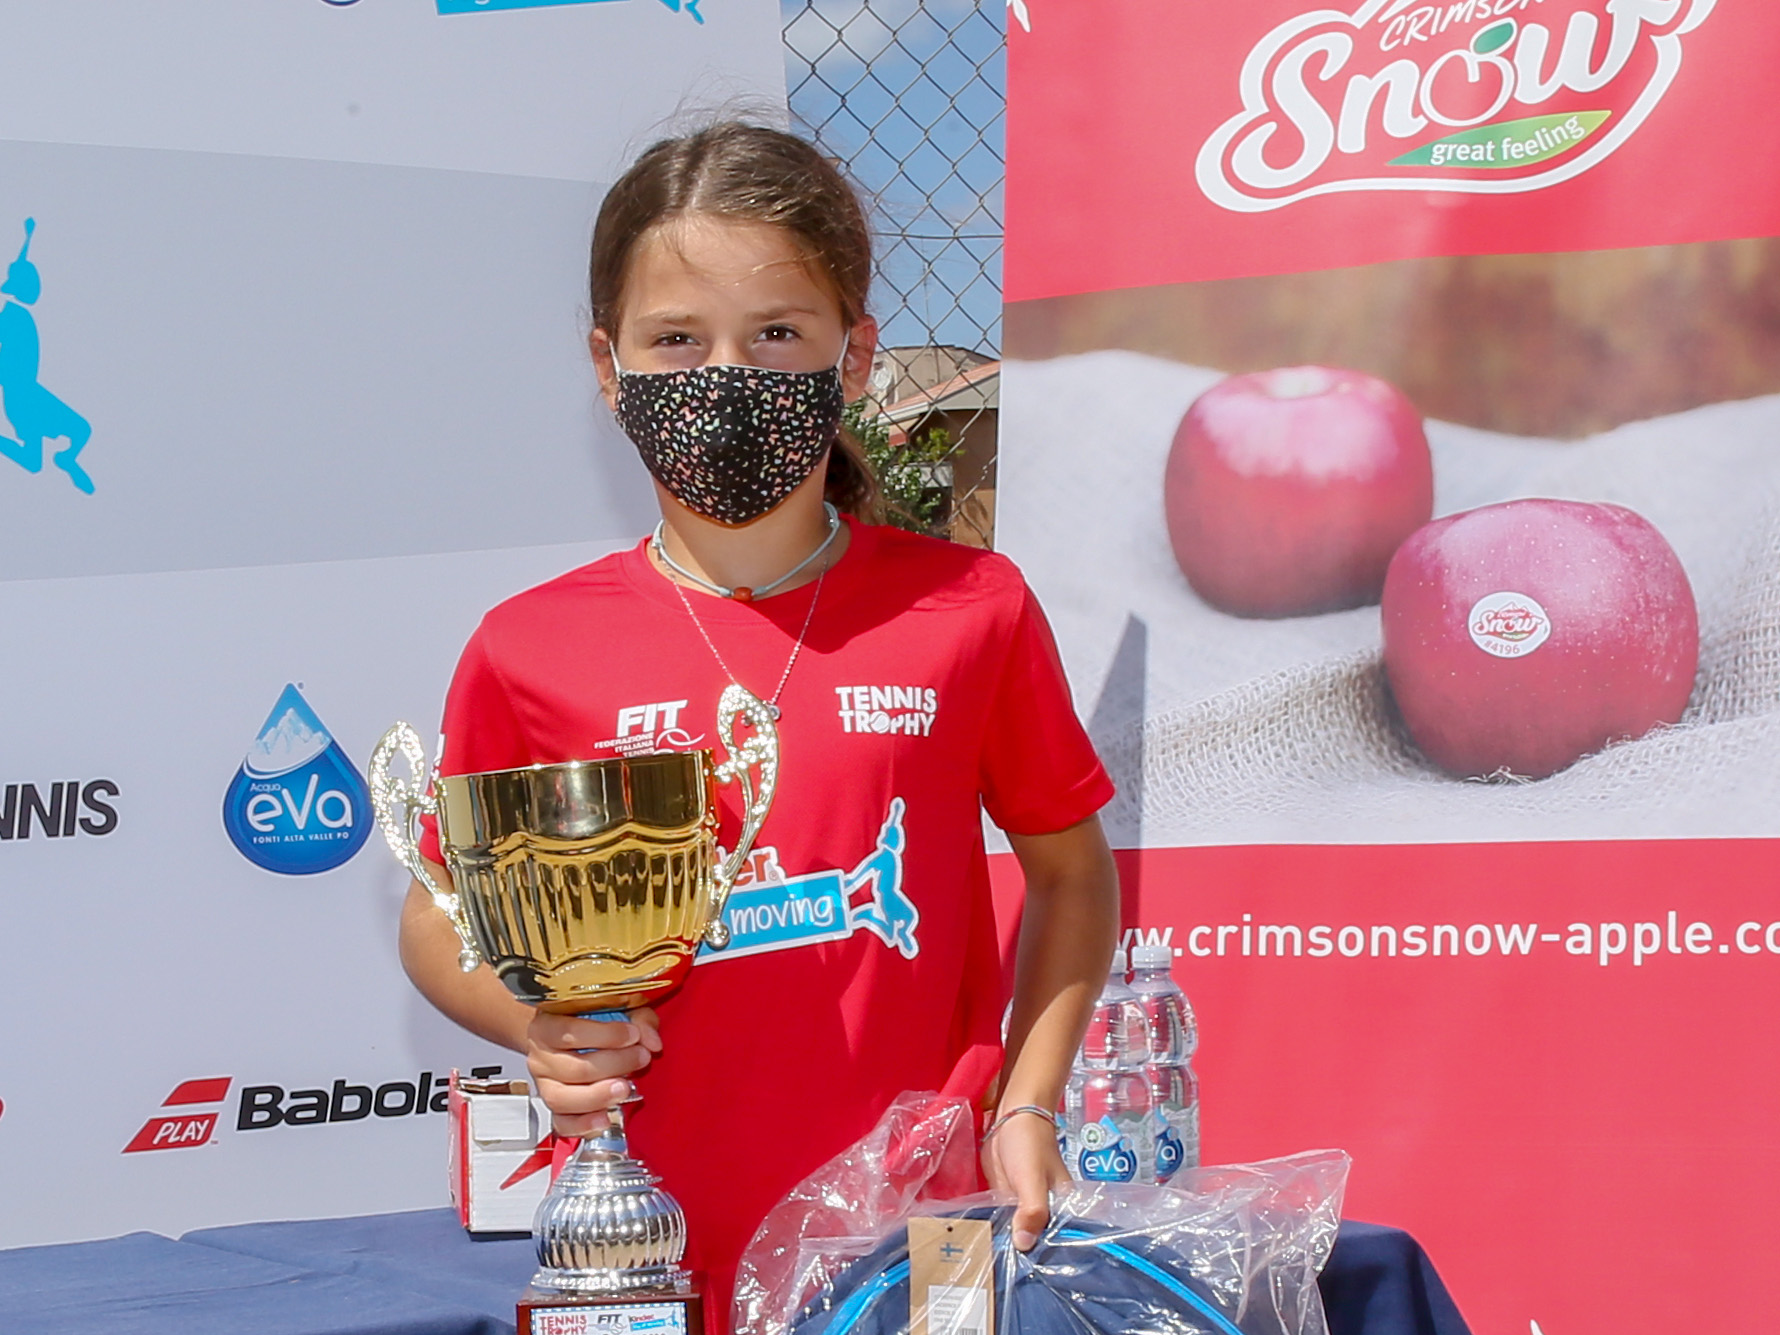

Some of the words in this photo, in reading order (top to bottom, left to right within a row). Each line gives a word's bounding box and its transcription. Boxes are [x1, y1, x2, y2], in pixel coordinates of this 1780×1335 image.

[1379, 0, 1545, 51] CRIMS
[1232, 0, 1681, 189] Snow
[1430, 138, 1496, 166] great
[1501, 115, 1586, 161] feeling
[1473, 610, 1545, 635] Snow
[1484, 640, 1521, 655] #4196
[835, 685, 938, 714] TENNIS
[617, 699, 689, 738] FIT
[838, 710, 936, 737] TROPHY
[594, 732, 655, 749] FEDERAZIONE
[614, 740, 655, 753] ITALIANA
[253, 836, 280, 844] FONTI
[284, 834, 305, 843] ALTA
[308, 833, 333, 841] VALLE
[337, 831, 350, 840] PO
[730, 893, 834, 936] moving
[152, 1119, 210, 1145] PLAY
[539, 1314, 587, 1327] TENNIS
[597, 1313, 623, 1324] FIT
